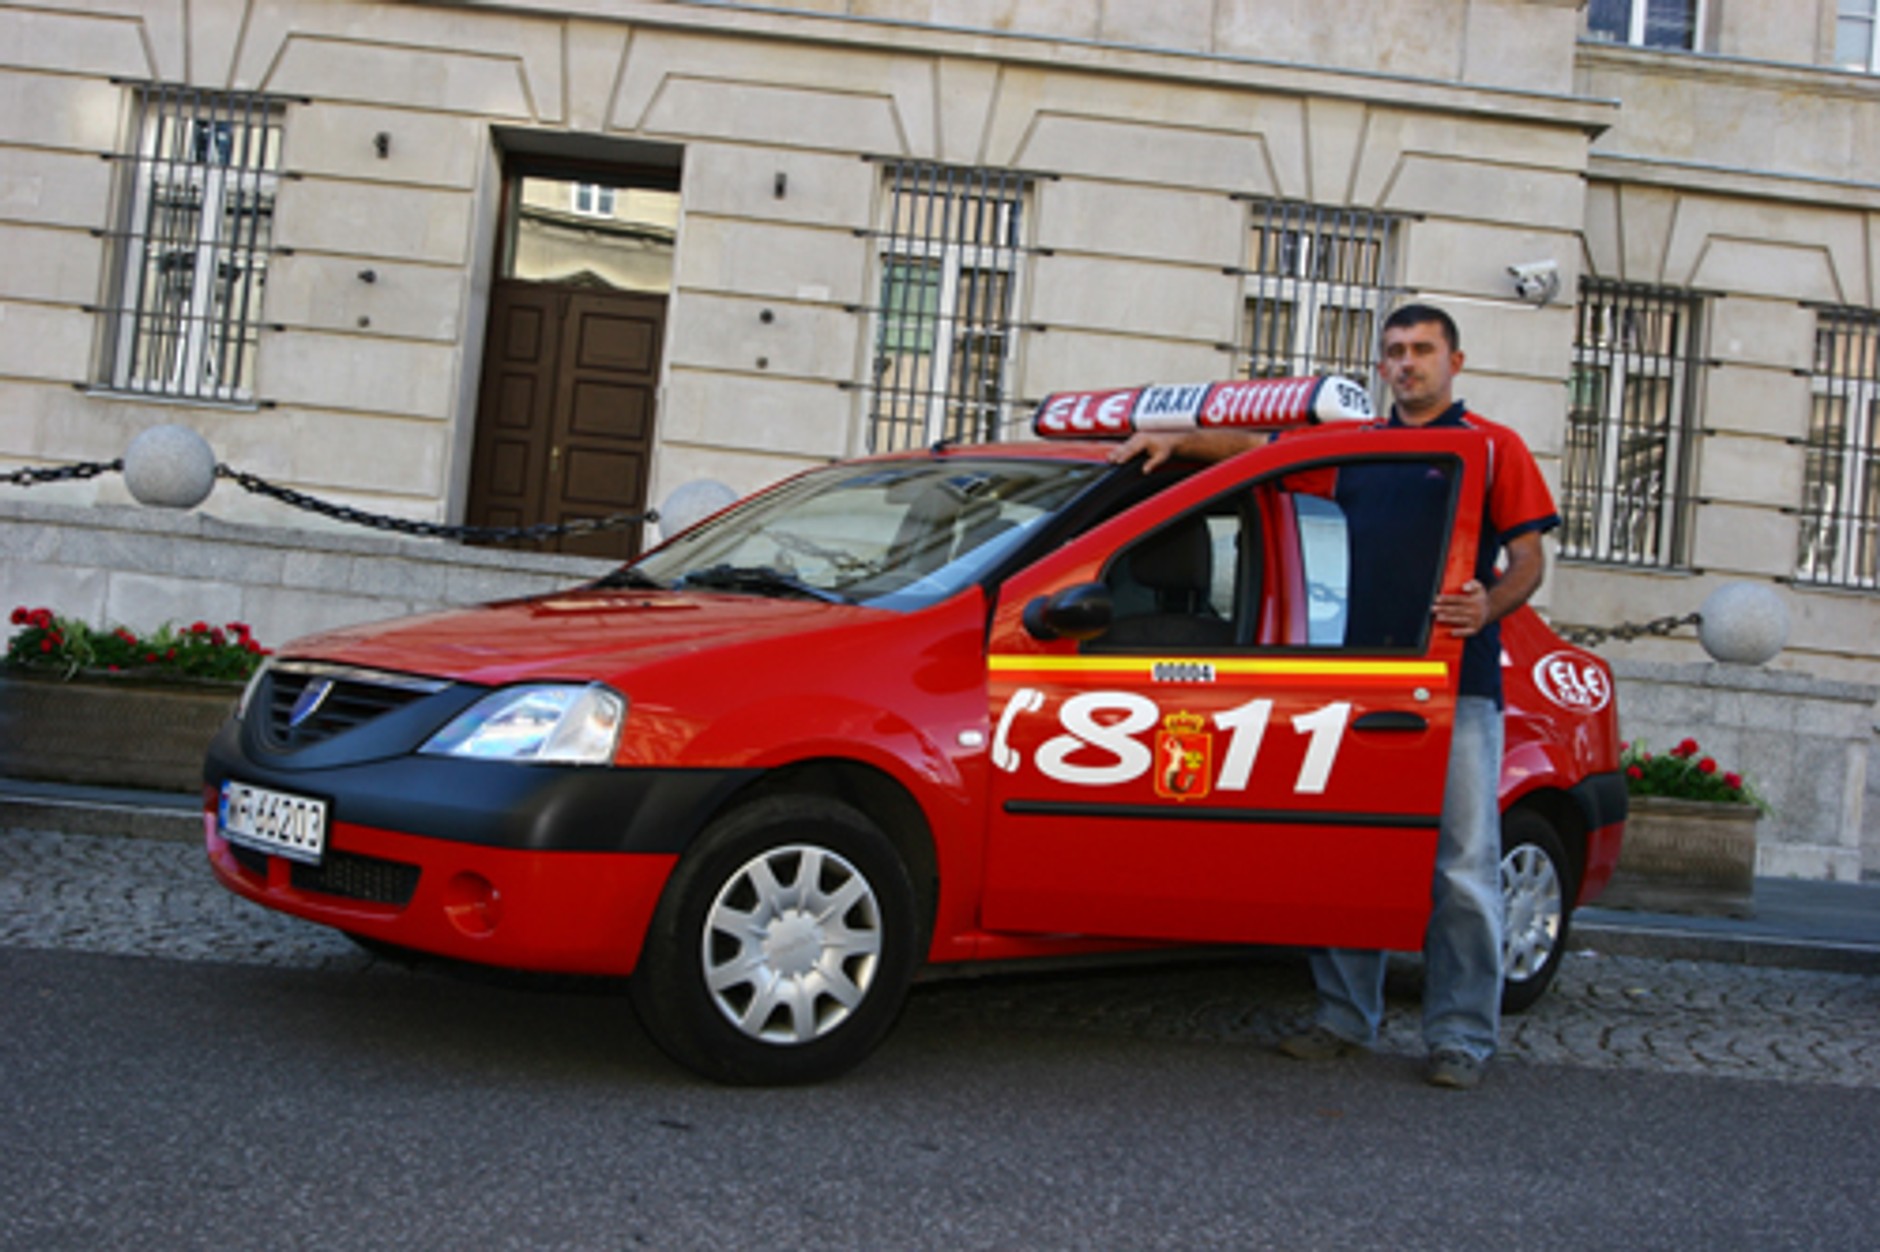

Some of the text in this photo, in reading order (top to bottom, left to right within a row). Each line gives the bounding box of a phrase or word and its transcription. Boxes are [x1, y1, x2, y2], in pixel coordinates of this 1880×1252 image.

[1044, 393, 1130, 430] ELE
[1145, 386, 1200, 415] TAXI
[1206, 381, 1310, 423] 8111111
[1549, 661, 1602, 697] ELE
